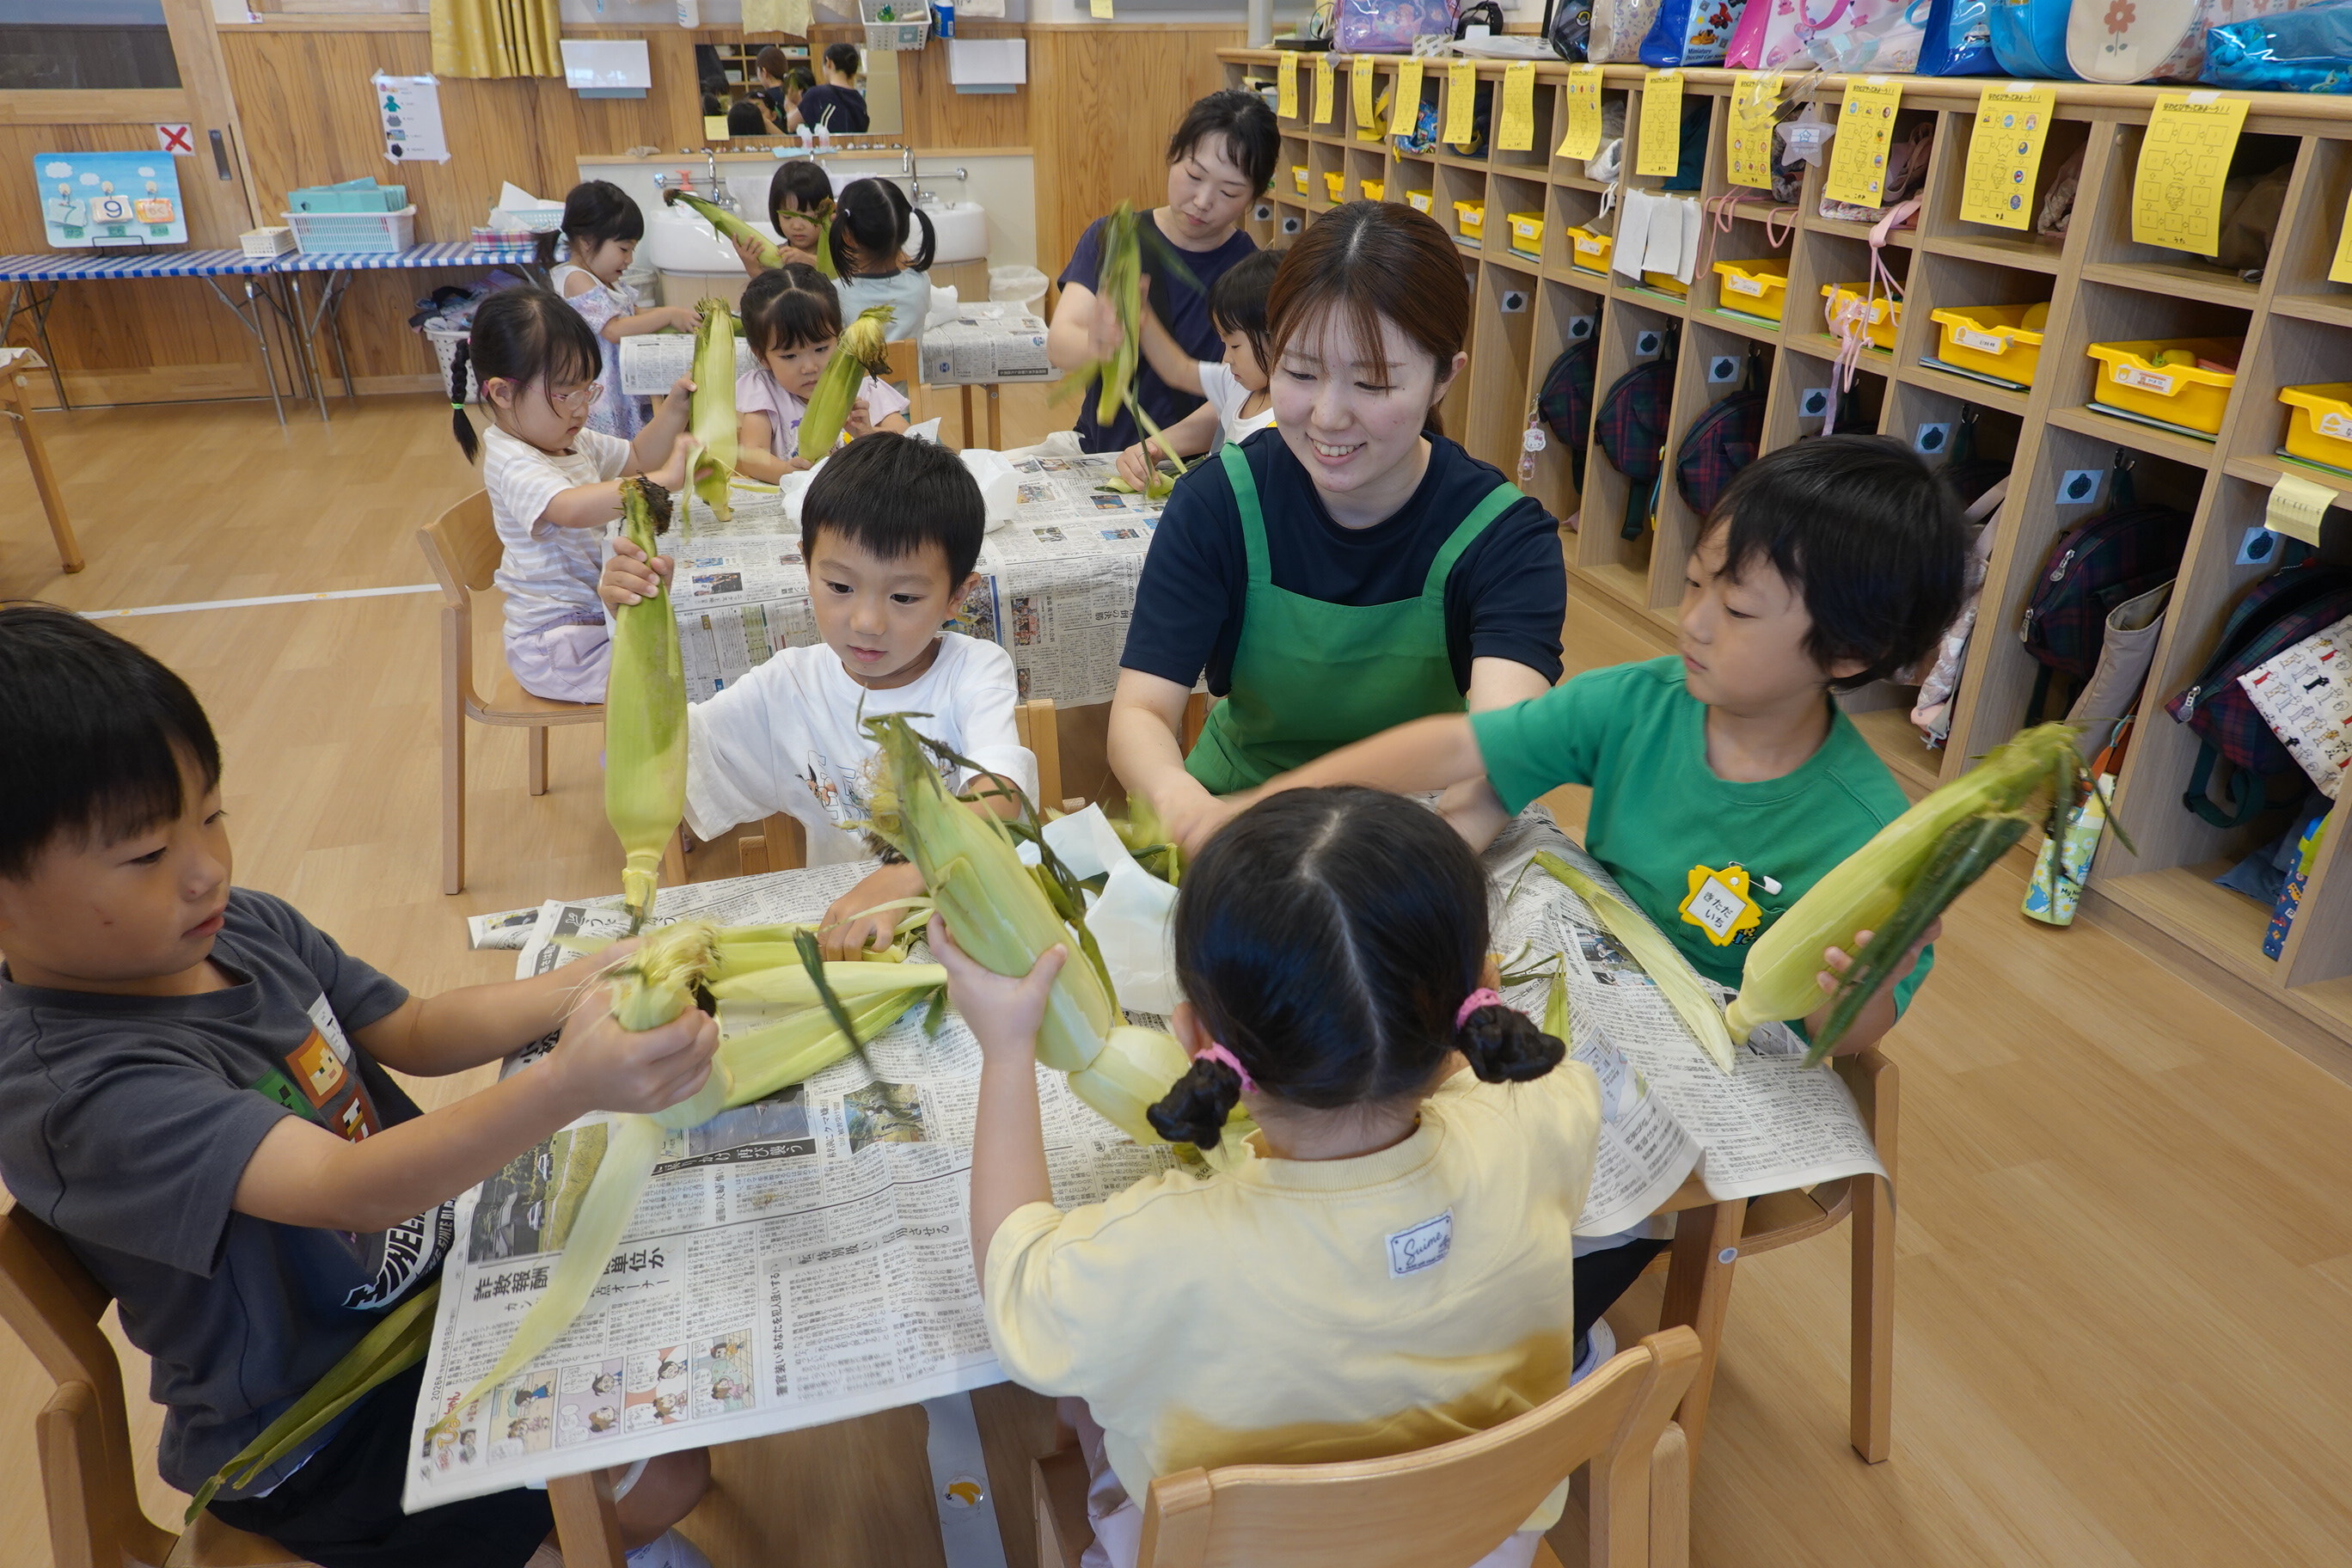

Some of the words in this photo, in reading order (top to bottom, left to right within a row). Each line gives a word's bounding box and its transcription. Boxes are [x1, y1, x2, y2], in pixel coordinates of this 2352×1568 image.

[104, 199, 122, 218] 9
[1703, 891, 1734, 918] きただ
[1705, 909, 1724, 928] いち
[437, 1221, 454, 1252] SINCE
[473, 1265, 551, 1302] 詐欺報酬
